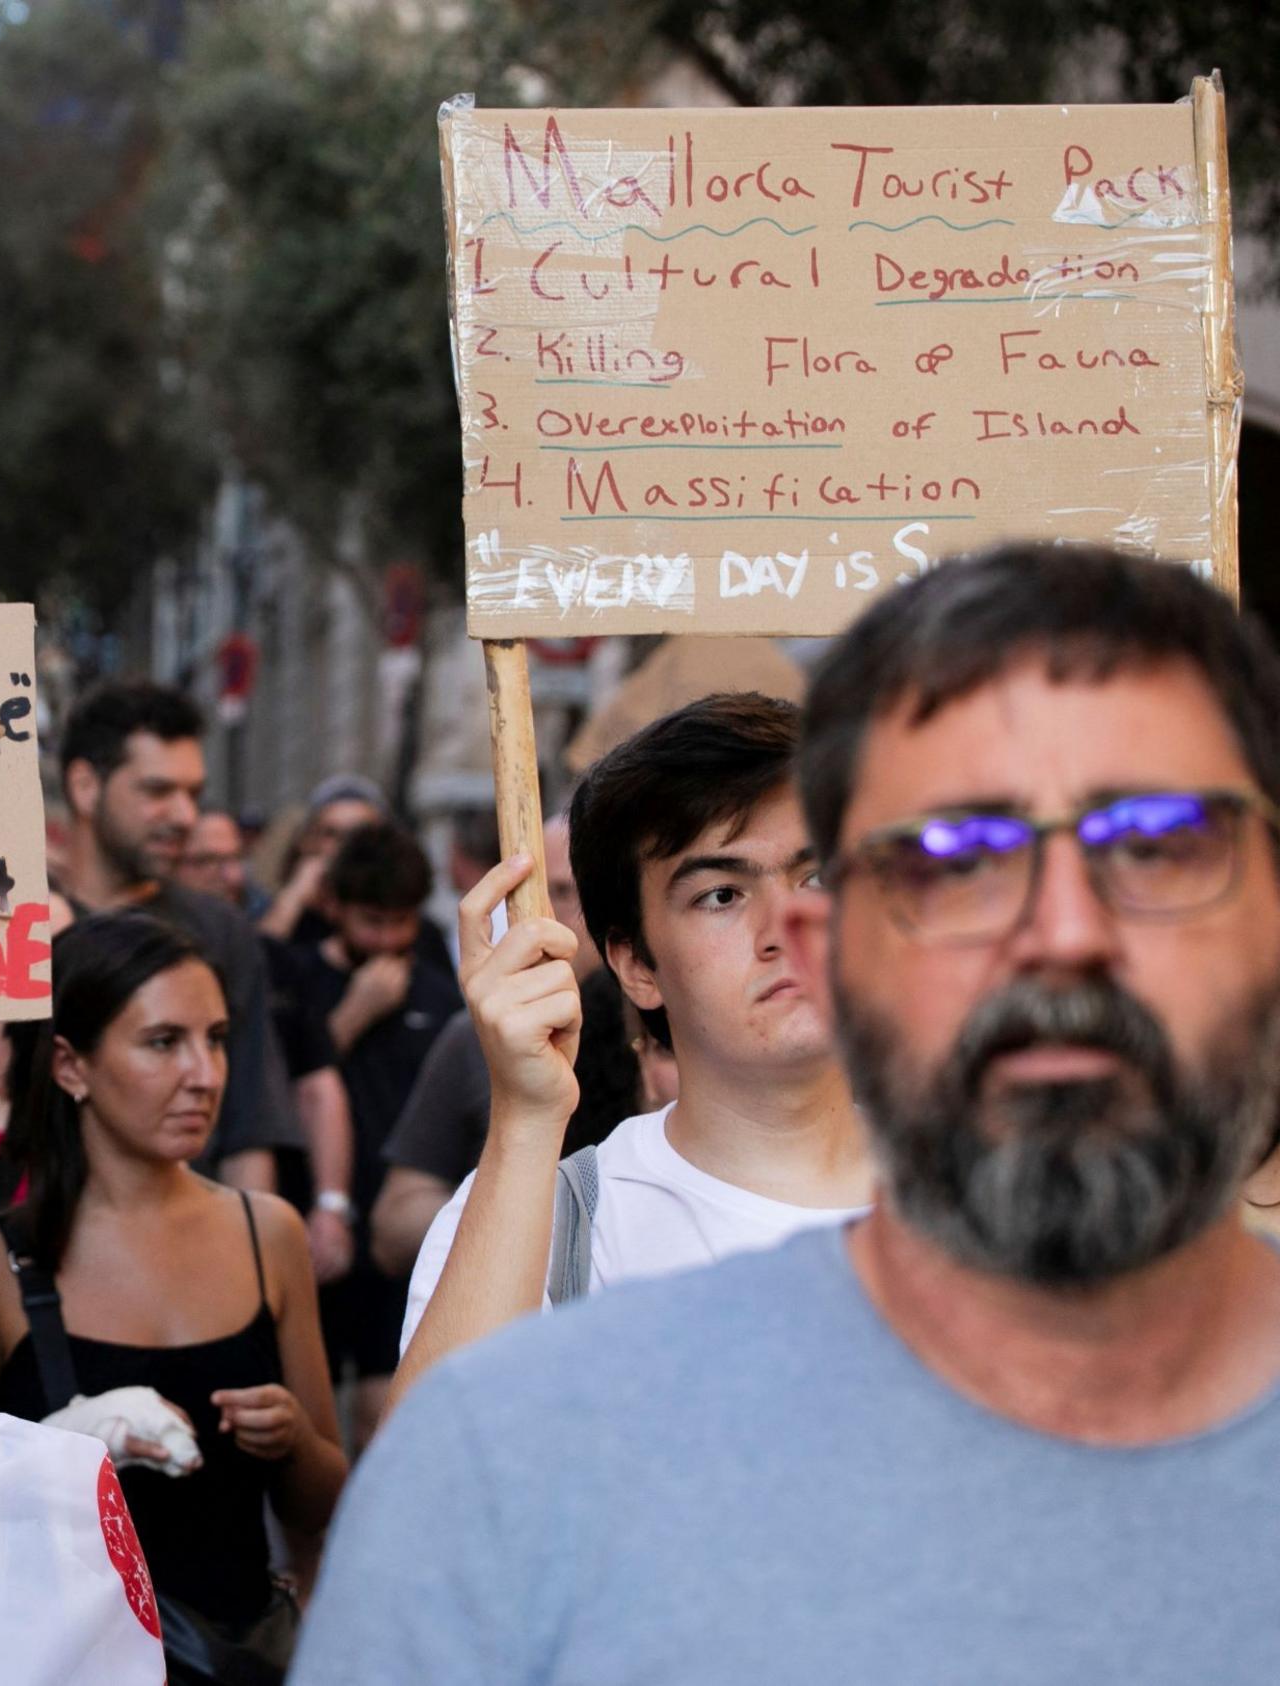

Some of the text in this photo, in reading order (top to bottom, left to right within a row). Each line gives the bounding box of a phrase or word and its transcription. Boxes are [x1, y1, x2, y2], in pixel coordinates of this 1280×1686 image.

[504, 115, 816, 220] Mallorca
[831, 143, 1014, 208] Tourist
[529, 241, 820, 301] Cultural
[874, 252, 1140, 301] Degradation
[472, 324, 511, 362] 2.
[535, 331, 684, 382] Killing
[764, 336, 878, 387] Flora
[999, 329, 1161, 375] Fauna
[476, 391, 509, 431] 3.
[891, 411, 938, 440] of
[972, 405, 1142, 442] Island
[479, 455, 981, 515] 4. Massification
[719, 548, 809, 600] DAY
